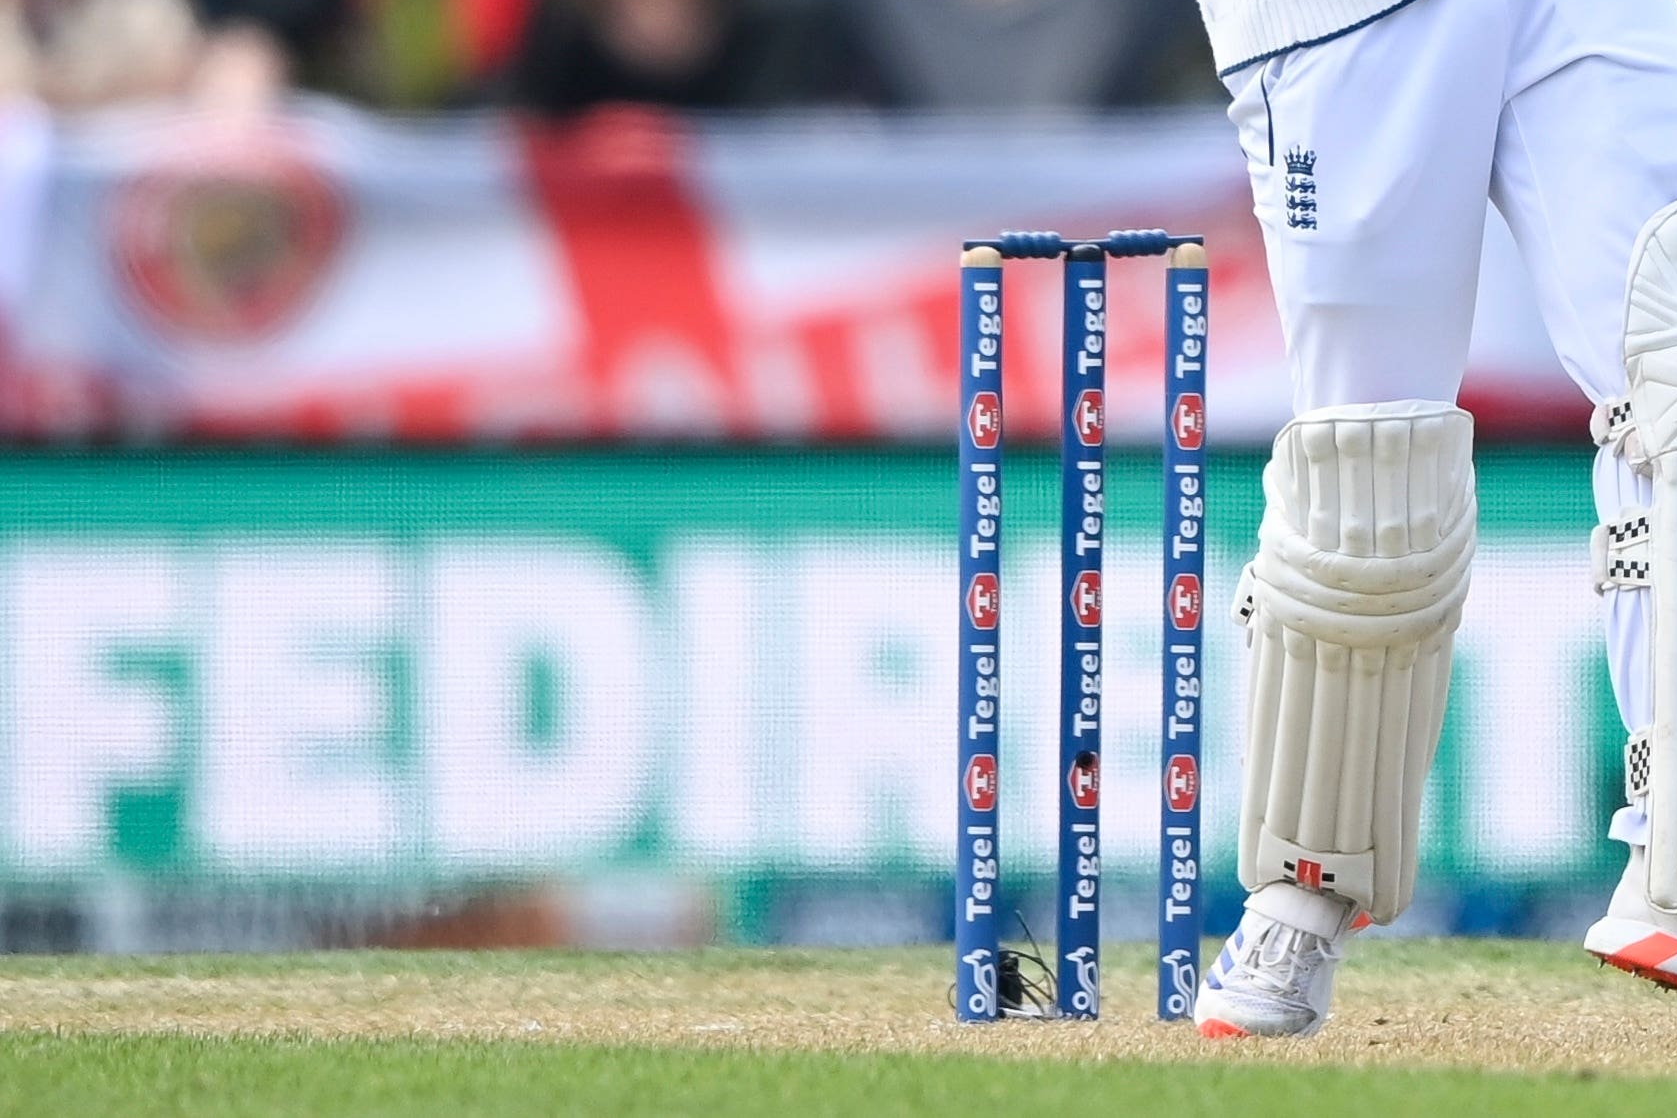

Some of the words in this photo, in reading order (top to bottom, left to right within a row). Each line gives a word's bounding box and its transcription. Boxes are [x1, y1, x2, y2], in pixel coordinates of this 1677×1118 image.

[971, 282, 1001, 378] Tegel
[1078, 279, 1105, 375] Tegel
[1175, 284, 1206, 378] Tegel
[970, 463, 1000, 559] Tegel
[1075, 461, 1103, 556] Tegel
[1172, 465, 1203, 559] Tegel
[969, 644, 999, 740] Tegel
[1073, 642, 1101, 738] Tegel
[1168, 645, 1199, 740] Tegel
[966, 826, 997, 922] Tegel
[1069, 824, 1099, 919] Tegel
[1166, 827, 1196, 922] Tegel
